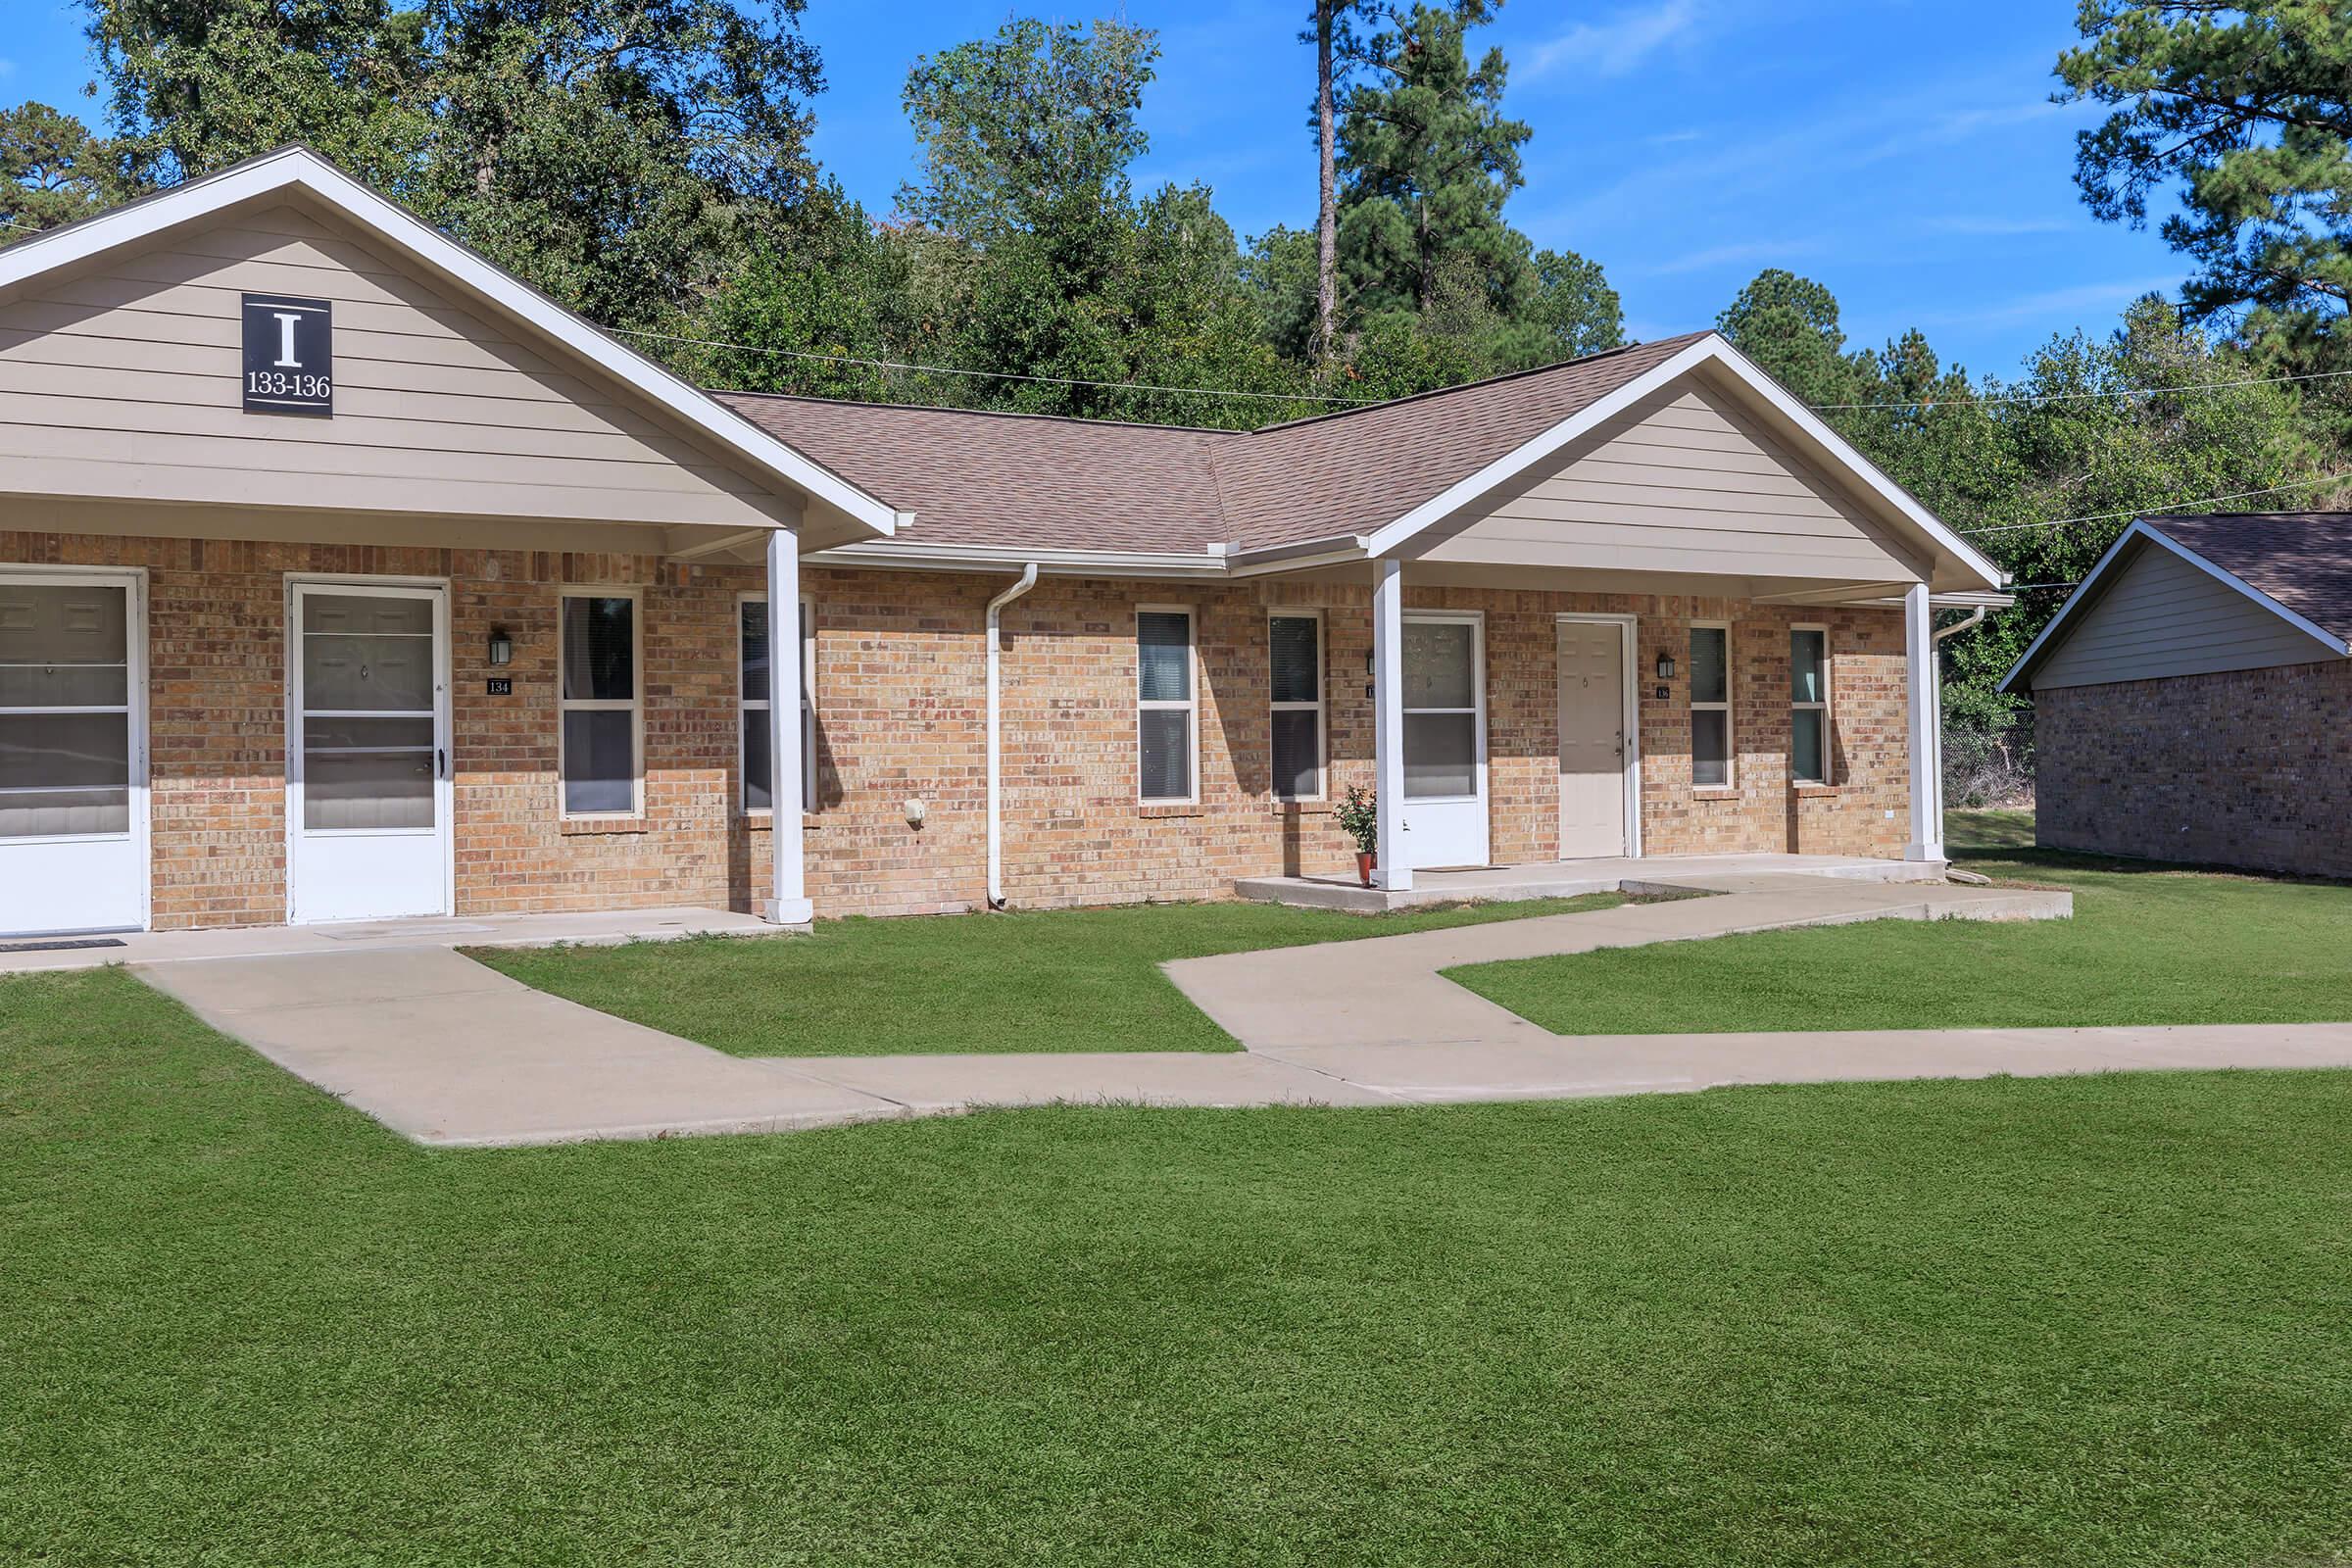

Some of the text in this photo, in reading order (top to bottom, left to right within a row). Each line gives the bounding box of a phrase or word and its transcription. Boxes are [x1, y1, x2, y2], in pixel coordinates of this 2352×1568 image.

[273, 313, 303, 368] I
[248, 370, 330, 398] 133-136
[490, 681, 509, 693] 134
